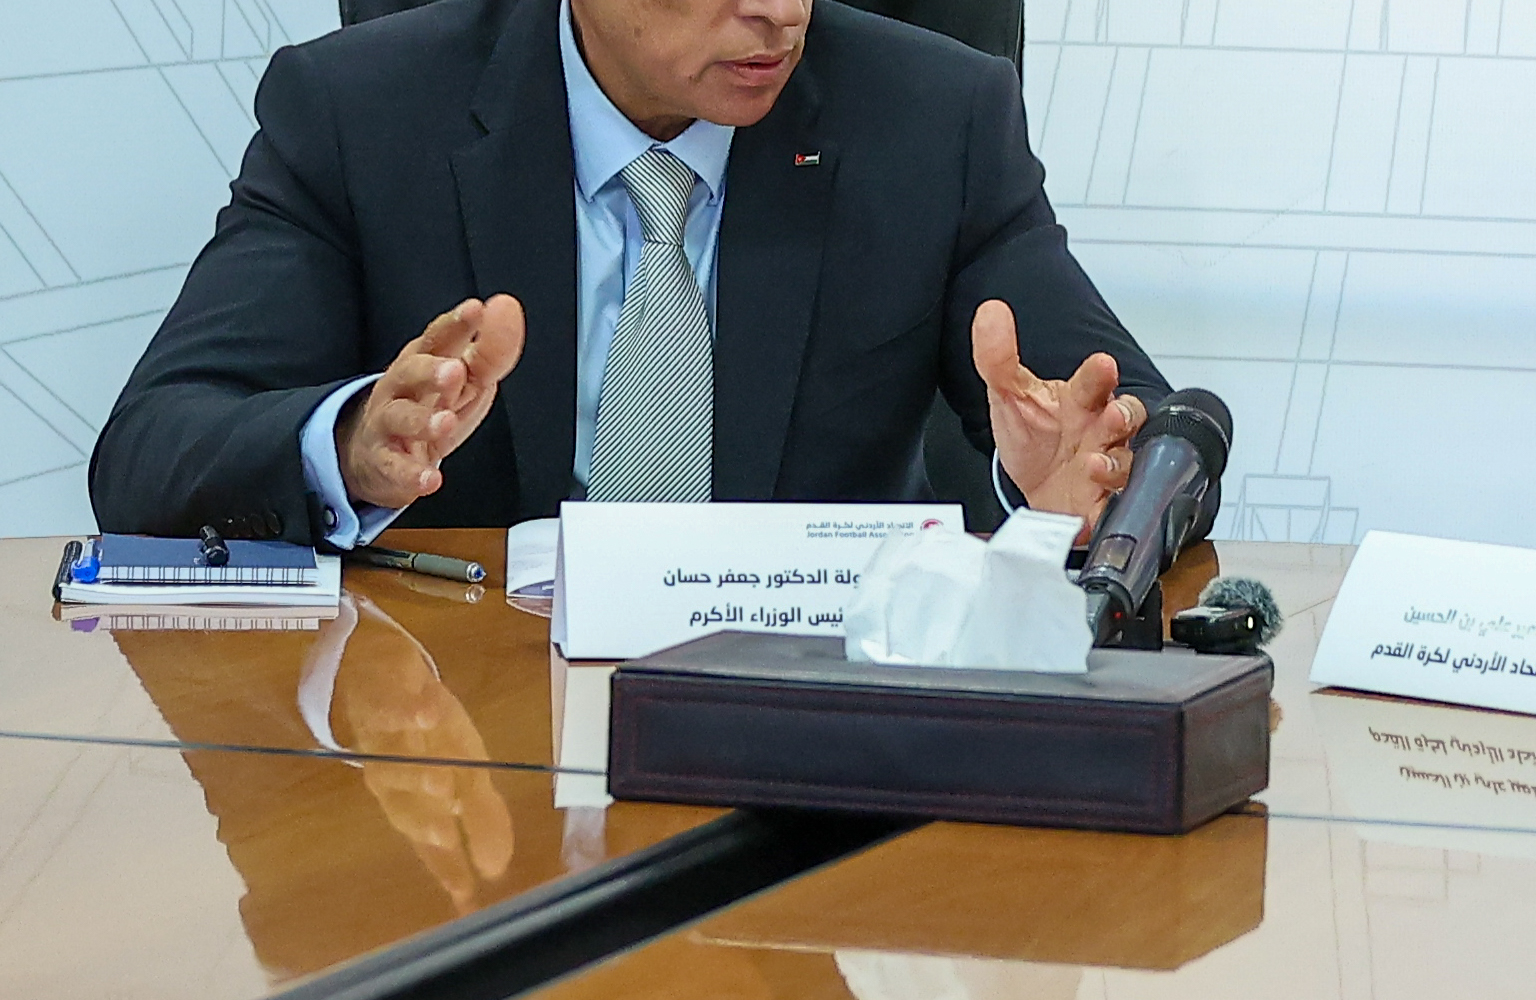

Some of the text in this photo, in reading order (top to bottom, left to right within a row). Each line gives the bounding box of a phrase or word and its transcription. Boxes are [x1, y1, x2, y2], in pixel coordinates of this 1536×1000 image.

[806, 530, 833, 539] Jordan
[835, 530, 867, 539] Football
[663, 567, 862, 589] ولة الدكتور جعفر حسان
[689, 602, 844, 628] ئيس الوزراء الأكرم
[1403, 605, 1458, 626] الحسين
[1370, 641, 1415, 660] القدم
[1416, 644, 1451, 667] لكرة
[1452, 651, 1507, 675] الأردني
